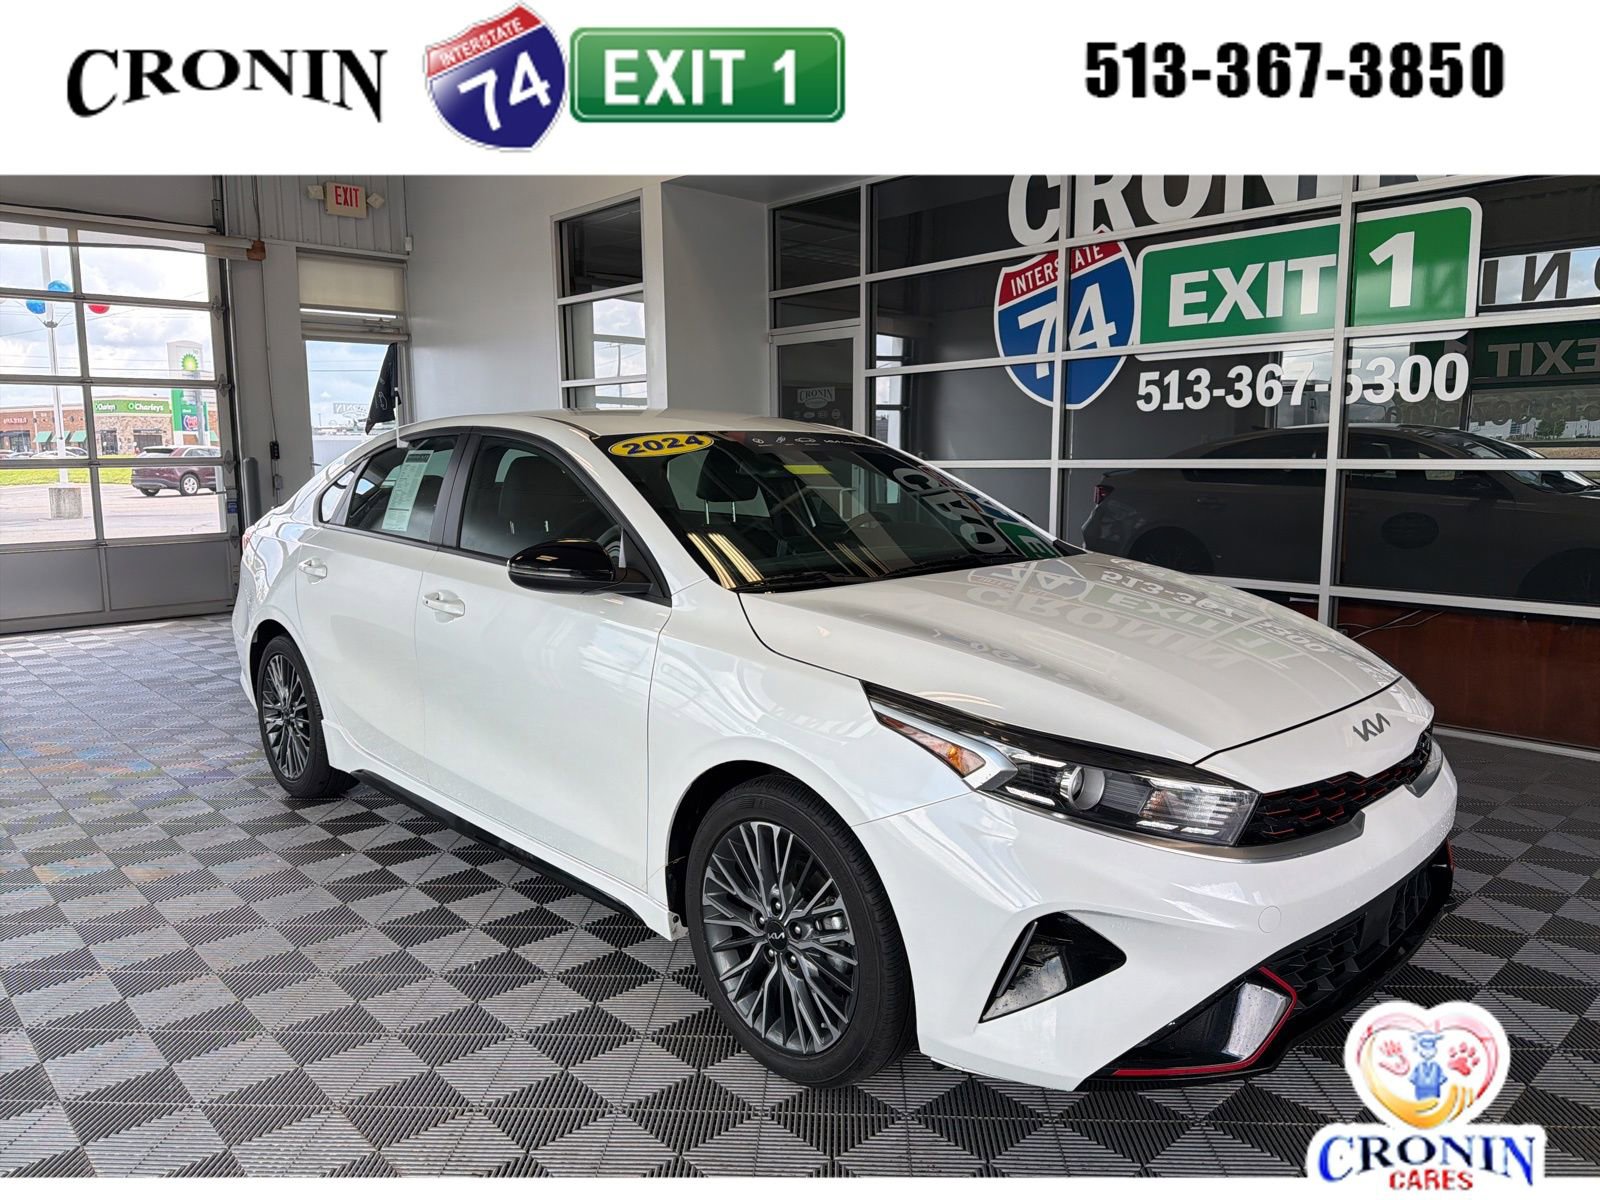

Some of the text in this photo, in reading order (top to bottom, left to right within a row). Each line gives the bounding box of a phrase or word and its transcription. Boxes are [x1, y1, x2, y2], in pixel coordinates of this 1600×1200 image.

[334, 185, 361, 208] EXIT
[1010, 244, 1105, 298] INTERSATE
[1169, 231, 1415, 328] EXIT 1
[1017, 282, 1118, 380] 74
[1136, 352, 1469, 413] 513-367-5300
[621, 435, 706, 455] 2024
